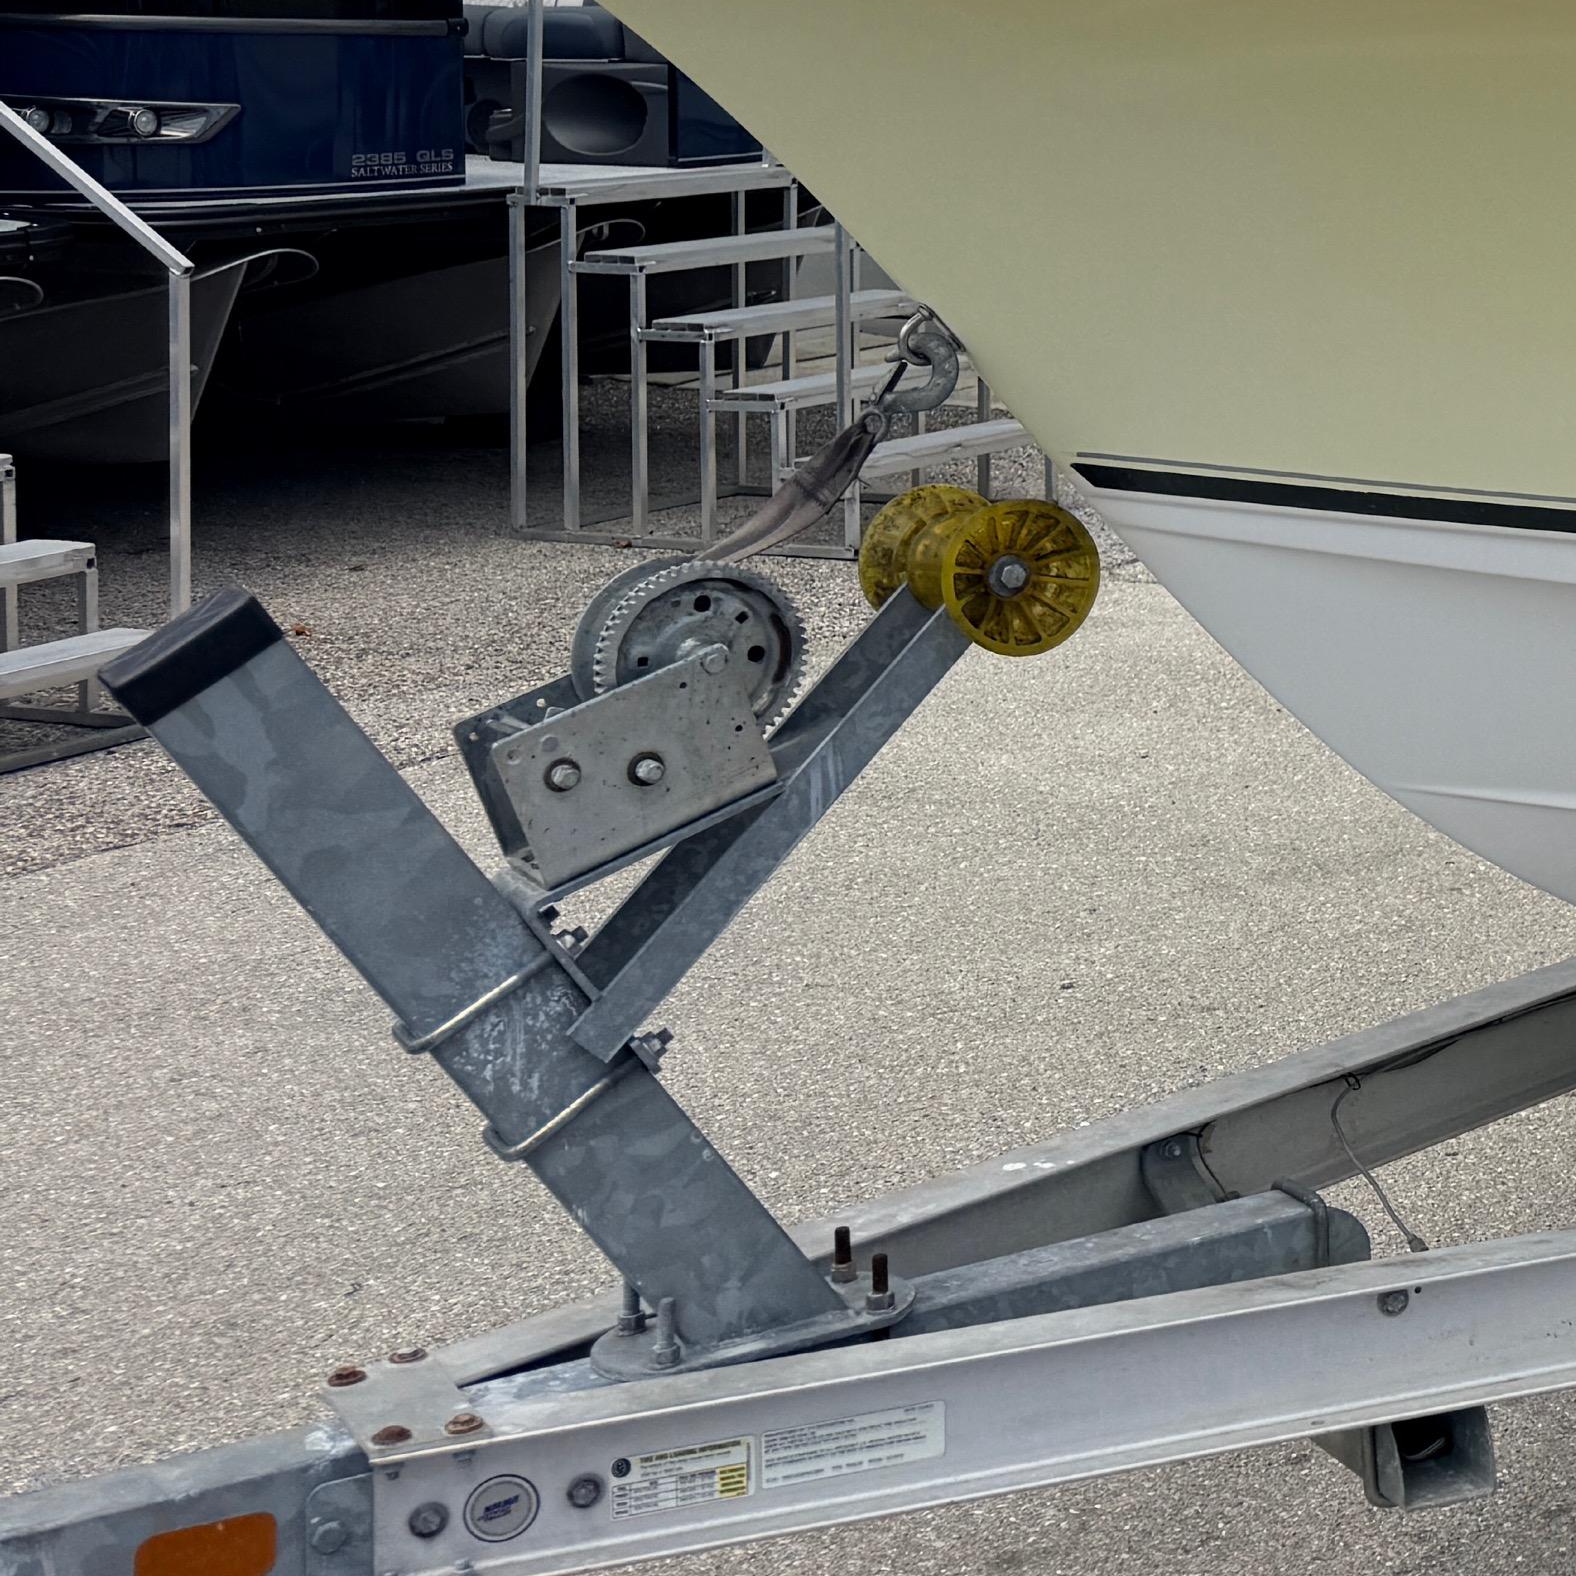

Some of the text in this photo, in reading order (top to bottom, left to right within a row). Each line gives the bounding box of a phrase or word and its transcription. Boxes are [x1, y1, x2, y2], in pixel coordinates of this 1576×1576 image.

[352, 152, 407, 166] 2385
[351, 162, 454, 178] SALTWATER SERIES
